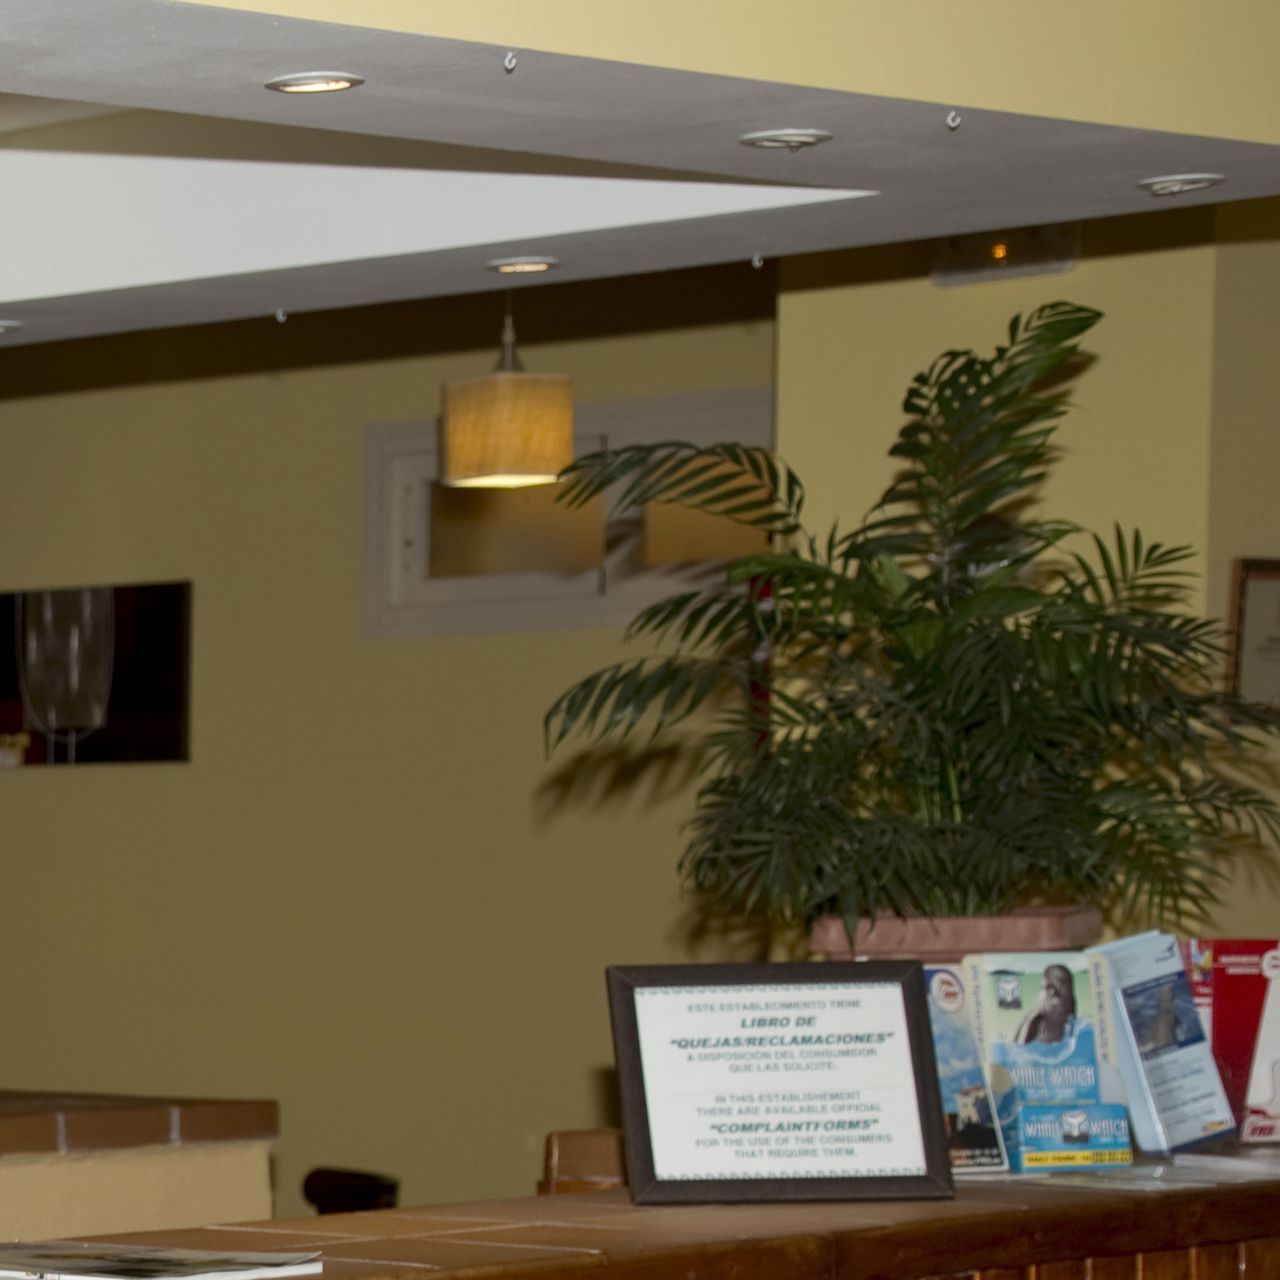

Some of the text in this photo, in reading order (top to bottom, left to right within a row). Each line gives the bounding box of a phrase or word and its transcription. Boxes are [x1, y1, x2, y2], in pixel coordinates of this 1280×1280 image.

[687, 1003, 716, 1013] ESTE
[740, 1016, 817, 1029] LIBRO DE
[729, 1063, 754, 1073] QUE
[757, 1062, 780, 1073] LAS
[715, 1094, 727, 1104] IN
[729, 1094, 756, 1104] THIS
[696, 1106, 733, 1117] THERE
[737, 1106, 761, 1116] ARE
[764, 1104, 829, 1116] AVAILABLE
[695, 1133, 894, 1148] FOR THE USE OF THE CONSUMERS
[733, 1149, 765, 1159] THAT
[767, 1148, 819, 1159] REQUIRE
